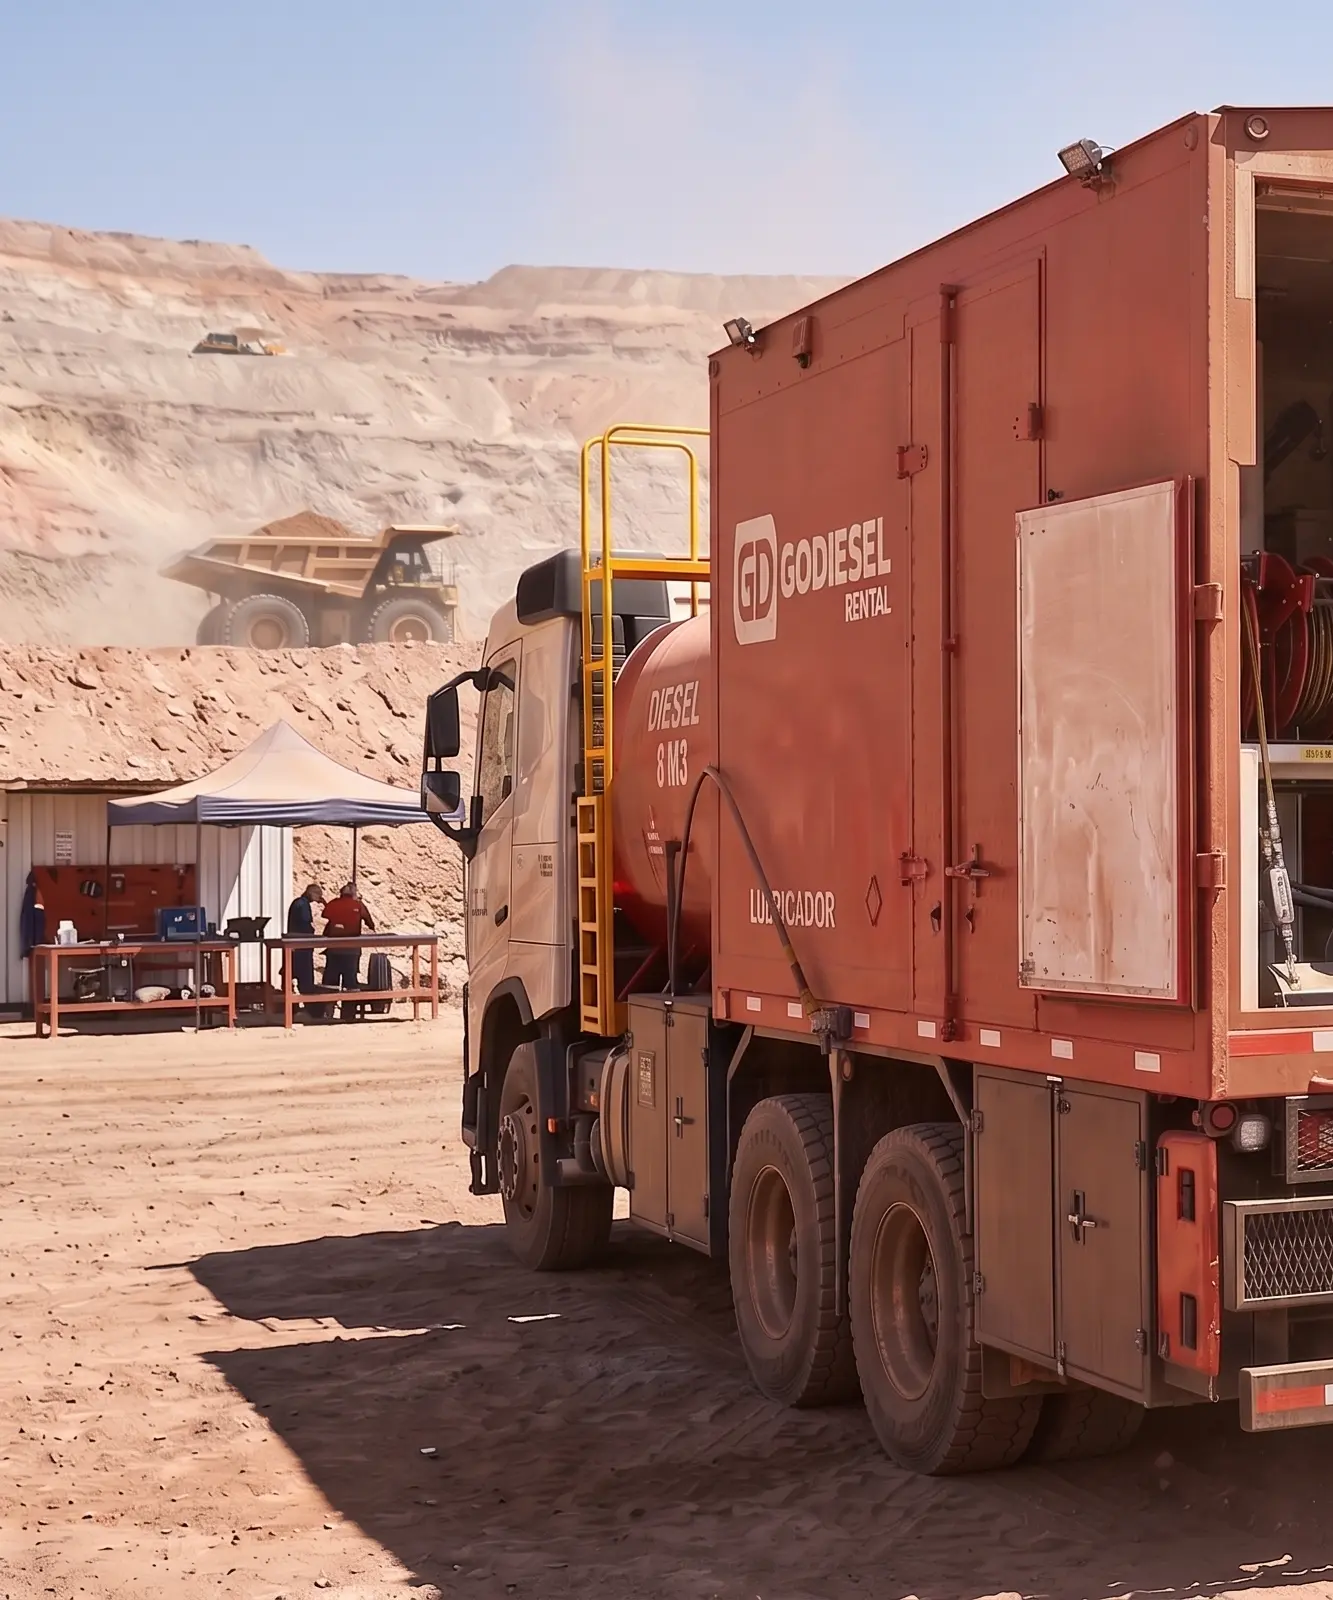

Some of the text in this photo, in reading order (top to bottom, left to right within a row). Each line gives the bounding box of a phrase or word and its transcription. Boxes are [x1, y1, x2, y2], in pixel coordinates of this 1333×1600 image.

[780, 516, 892, 618] GODIESEL
[845, 585, 892, 623] RENTAL
[647, 680, 700, 732] DIESEL
[656, 739, 689, 788] 8 M3
